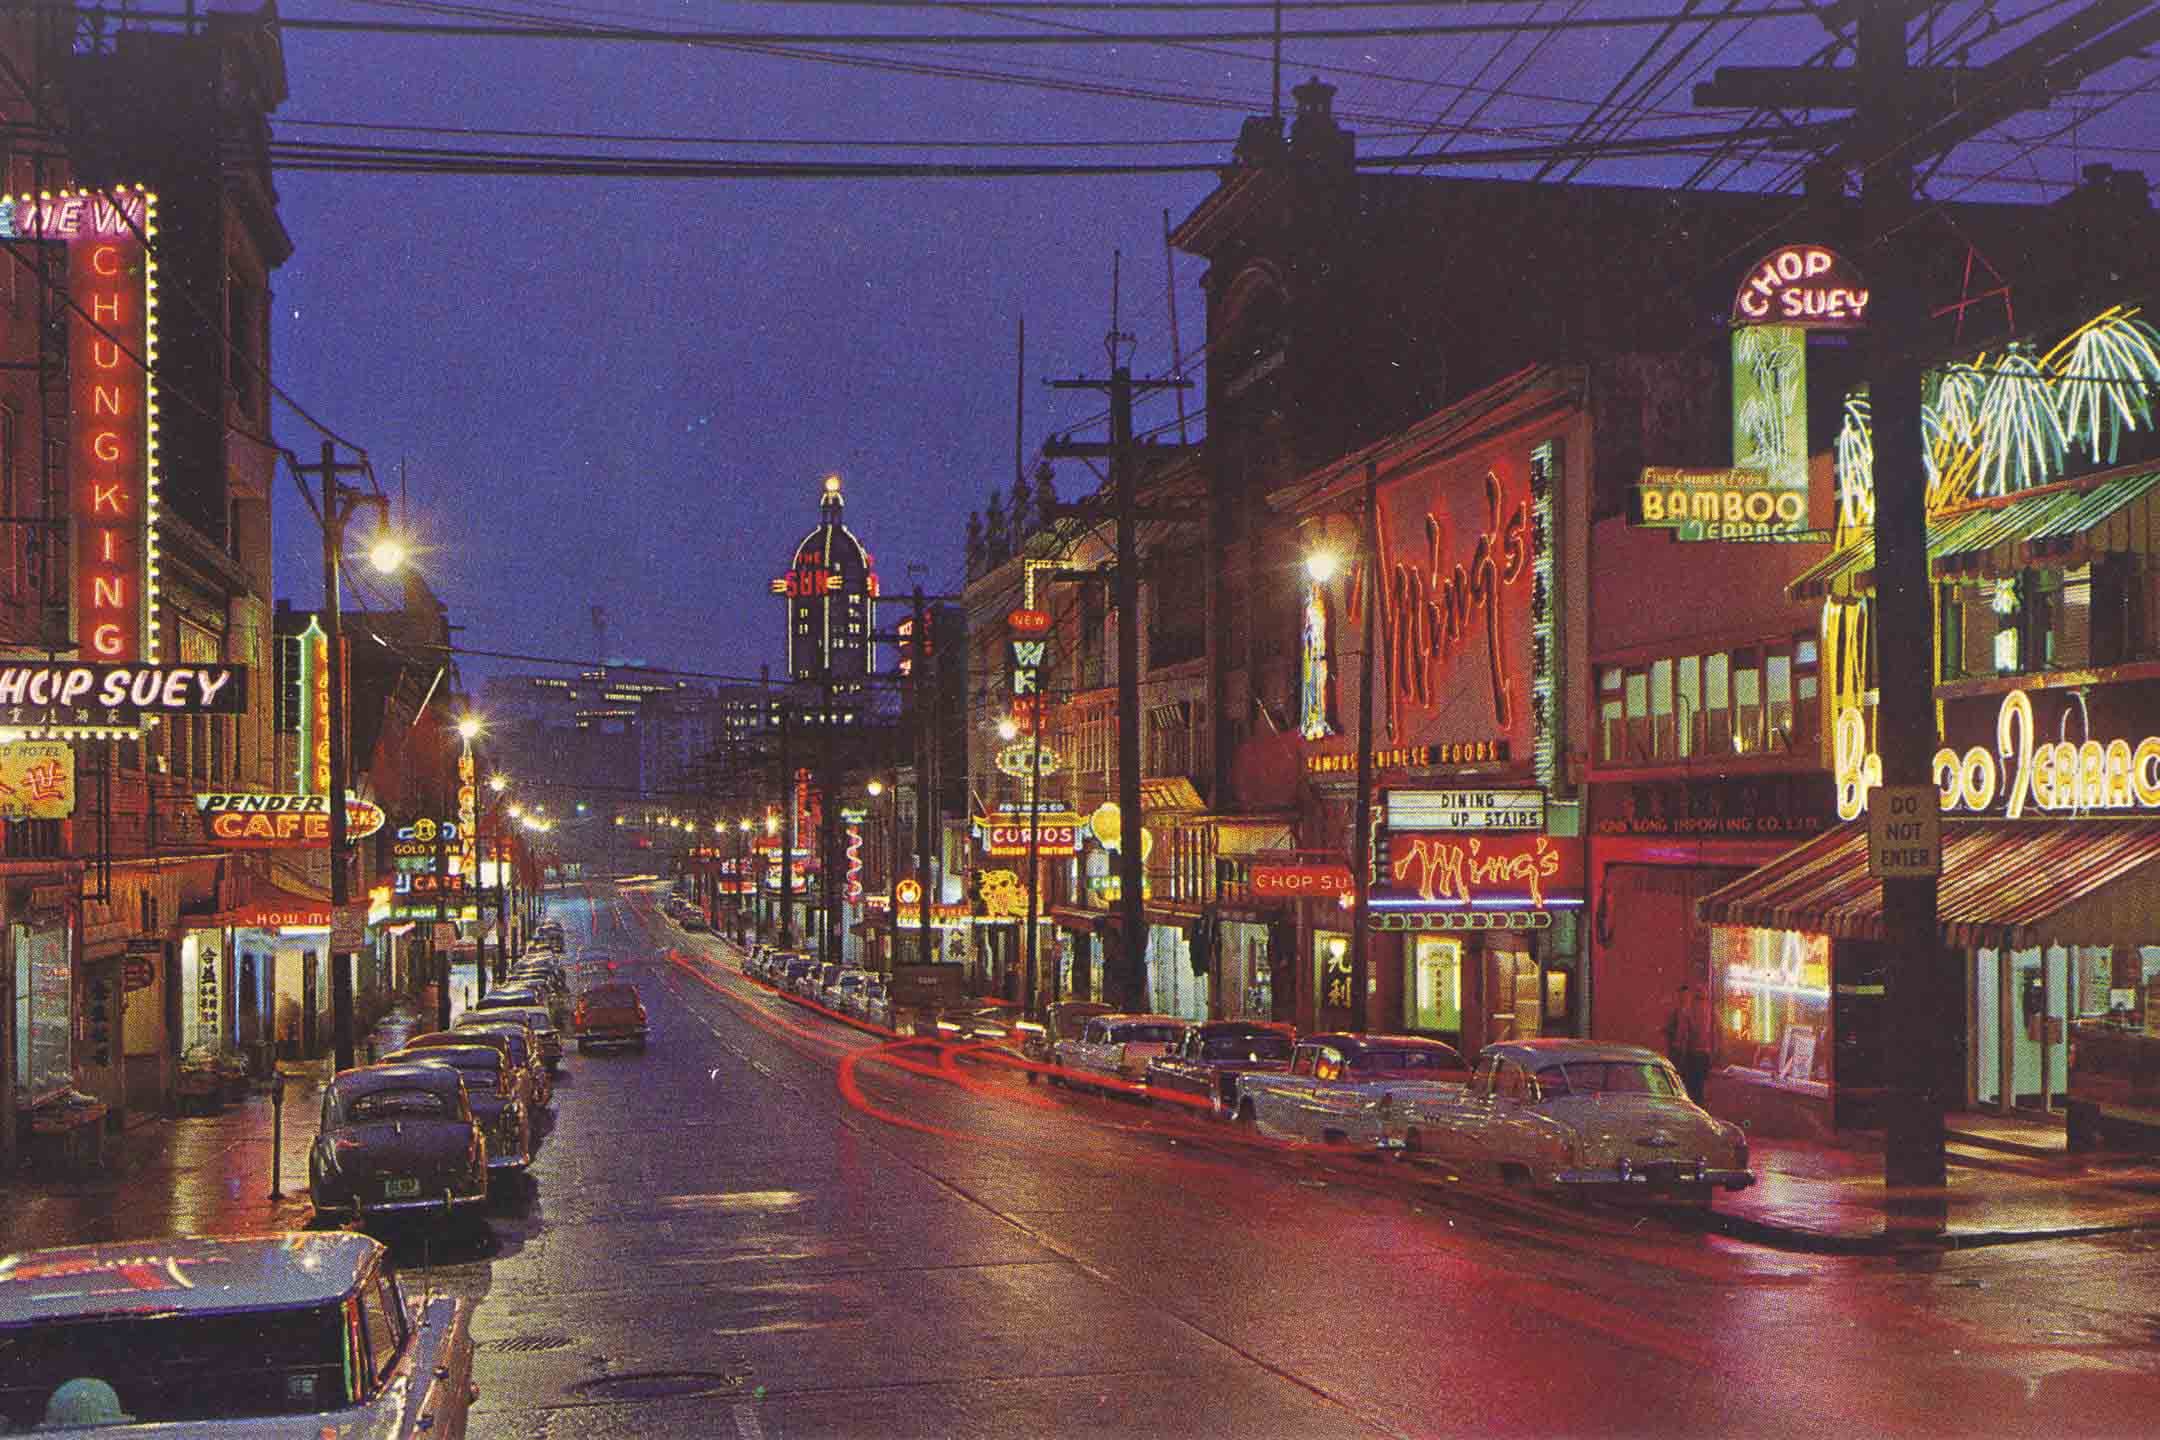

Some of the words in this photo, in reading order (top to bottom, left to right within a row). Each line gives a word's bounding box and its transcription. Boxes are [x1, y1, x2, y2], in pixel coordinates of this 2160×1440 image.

[24, 198, 139, 232] NEW
[1741, 251, 1832, 316] CHOP
[1780, 288, 1869, 317] SUEY
[1642, 490, 1806, 522] BAMBOO
[786, 570, 829, 597] SUN
[1014, 615, 1044, 625] NEW
[99, 667, 231, 706] SUEY
[1441, 741, 1497, 763] FOODS
[205, 795, 324, 811] PENDER
[1441, 794, 1495, 809] DINING
[1891, 797, 1918, 813] DO
[213, 812, 330, 839] CAFE
[1451, 811, 1470, 827] UP
[1485, 811, 1539, 827] STAIRS
[993, 827, 1072, 842] CURIOS
[1886, 824, 1922, 840] NOT
[1881, 849, 1929, 866] ENTER
[1256, 874, 1312, 889] CHOP
[1394, 838, 1560, 908] Ming's
[246, 912, 298, 925] HOW
